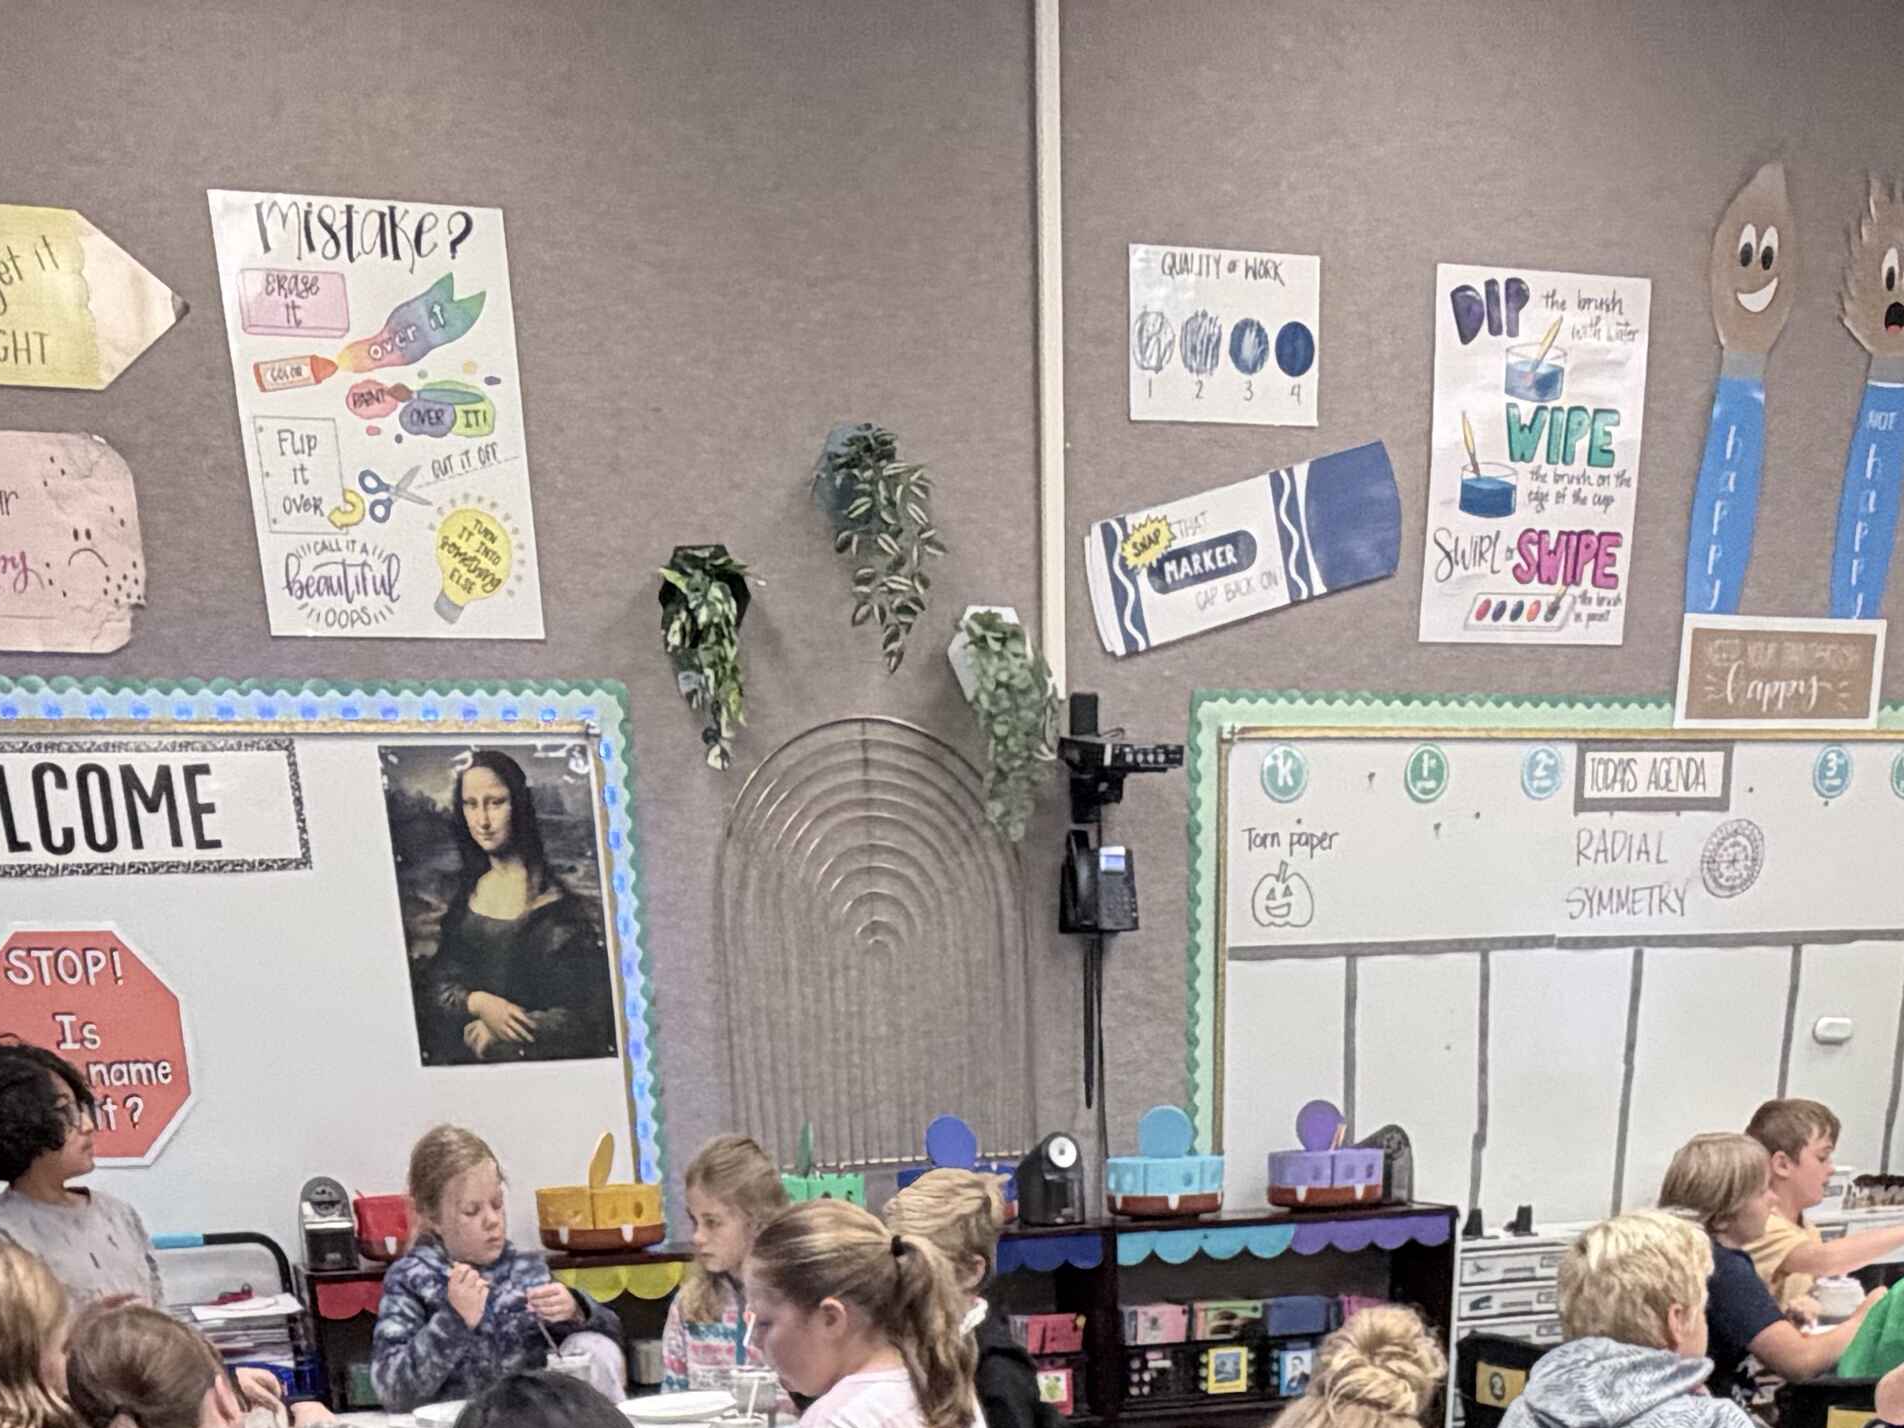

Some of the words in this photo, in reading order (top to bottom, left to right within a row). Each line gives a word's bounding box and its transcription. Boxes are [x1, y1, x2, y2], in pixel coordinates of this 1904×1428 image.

[35, 235, 60, 274] it
[1161, 251, 1221, 280] QUALITY
[1244, 257, 1286, 287] WORK
[1450, 277, 1530, 346] DIP
[1542, 289, 1567, 312] the
[1577, 289, 1624, 315] brush
[1195, 379, 1204, 399] 2
[1243, 380, 1254, 401] 3
[1506, 402, 1621, 468] WIPE
[1865, 410, 1897, 432] NOT
[1529, 465, 1548, 484] the
[1614, 469, 1632, 489] the
[283, 552, 401, 604] beautiful
[1163, 543, 1238, 585] MARKER
[1512, 528, 1623, 590] SWIPE
[1647, 757, 1707, 793] AGENDA
[1243, 828, 1280, 850] Torn
[1288, 831, 1339, 859] paper
[1576, 827, 1669, 868] RADIAL
[1566, 884, 1688, 920] SYMMETRY
[5, 947, 124, 987] STOP!
[53, 1012, 101, 1050] Is
[87, 1060, 173, 1087] name
